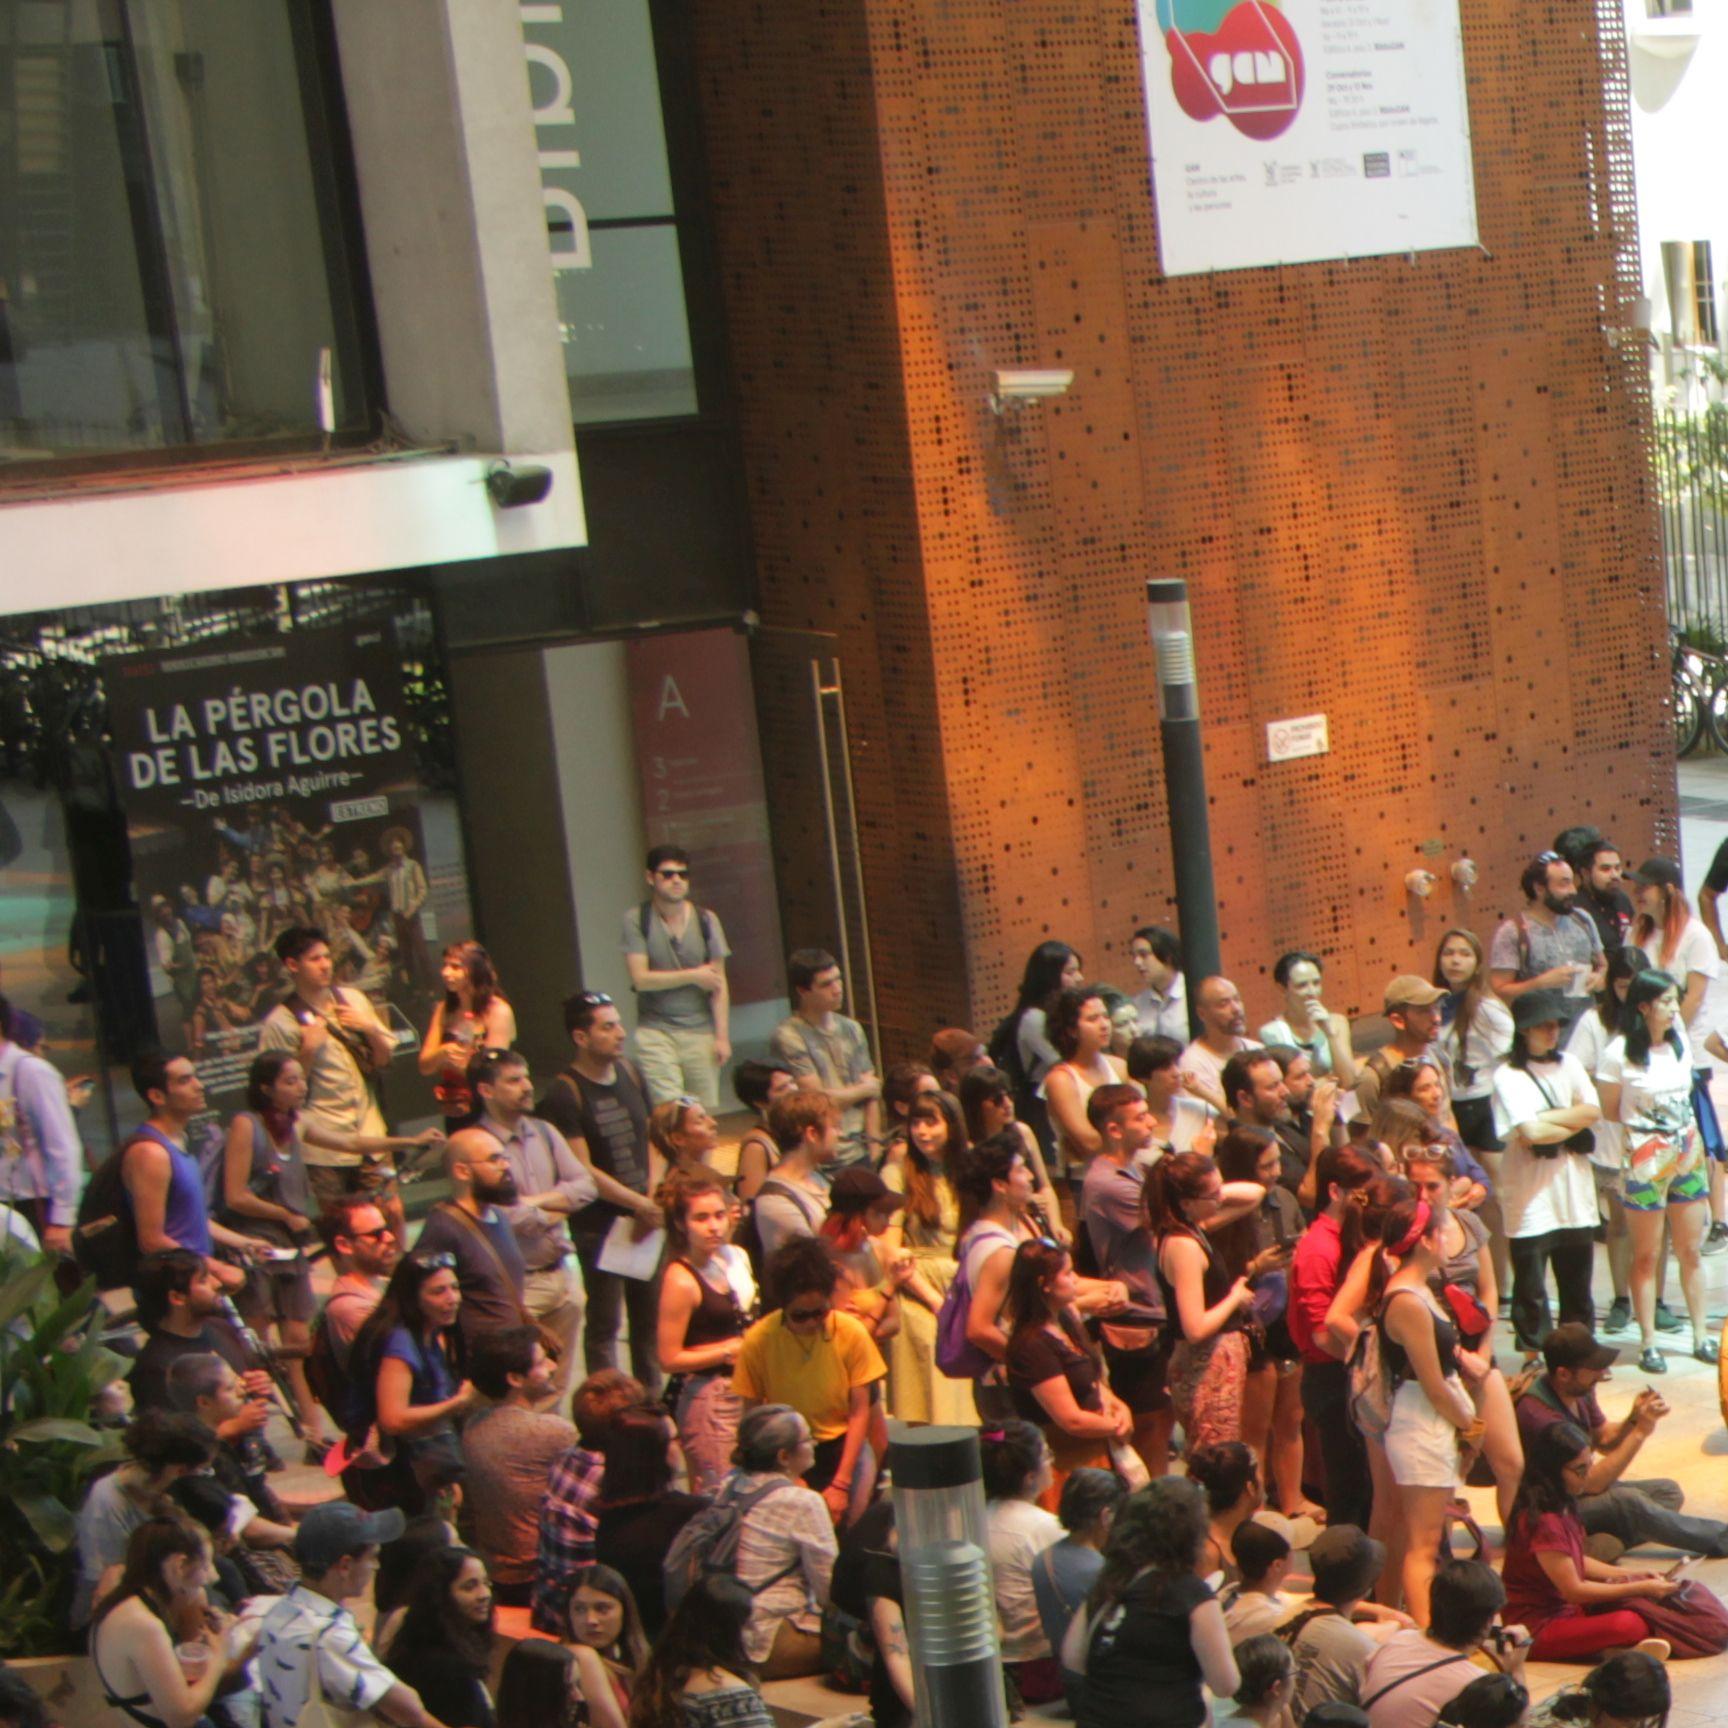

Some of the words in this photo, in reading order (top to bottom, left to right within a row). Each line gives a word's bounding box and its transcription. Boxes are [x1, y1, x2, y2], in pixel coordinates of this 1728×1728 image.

[147, 704, 196, 743] LA
[204, 679, 376, 735] PÉRGOLA
[657, 674, 690, 722] A
[129, 748, 181, 789] DE
[189, 737, 258, 780] LAS
[267, 716, 401, 768] FLORES
[224, 780, 284, 804] Isidora
